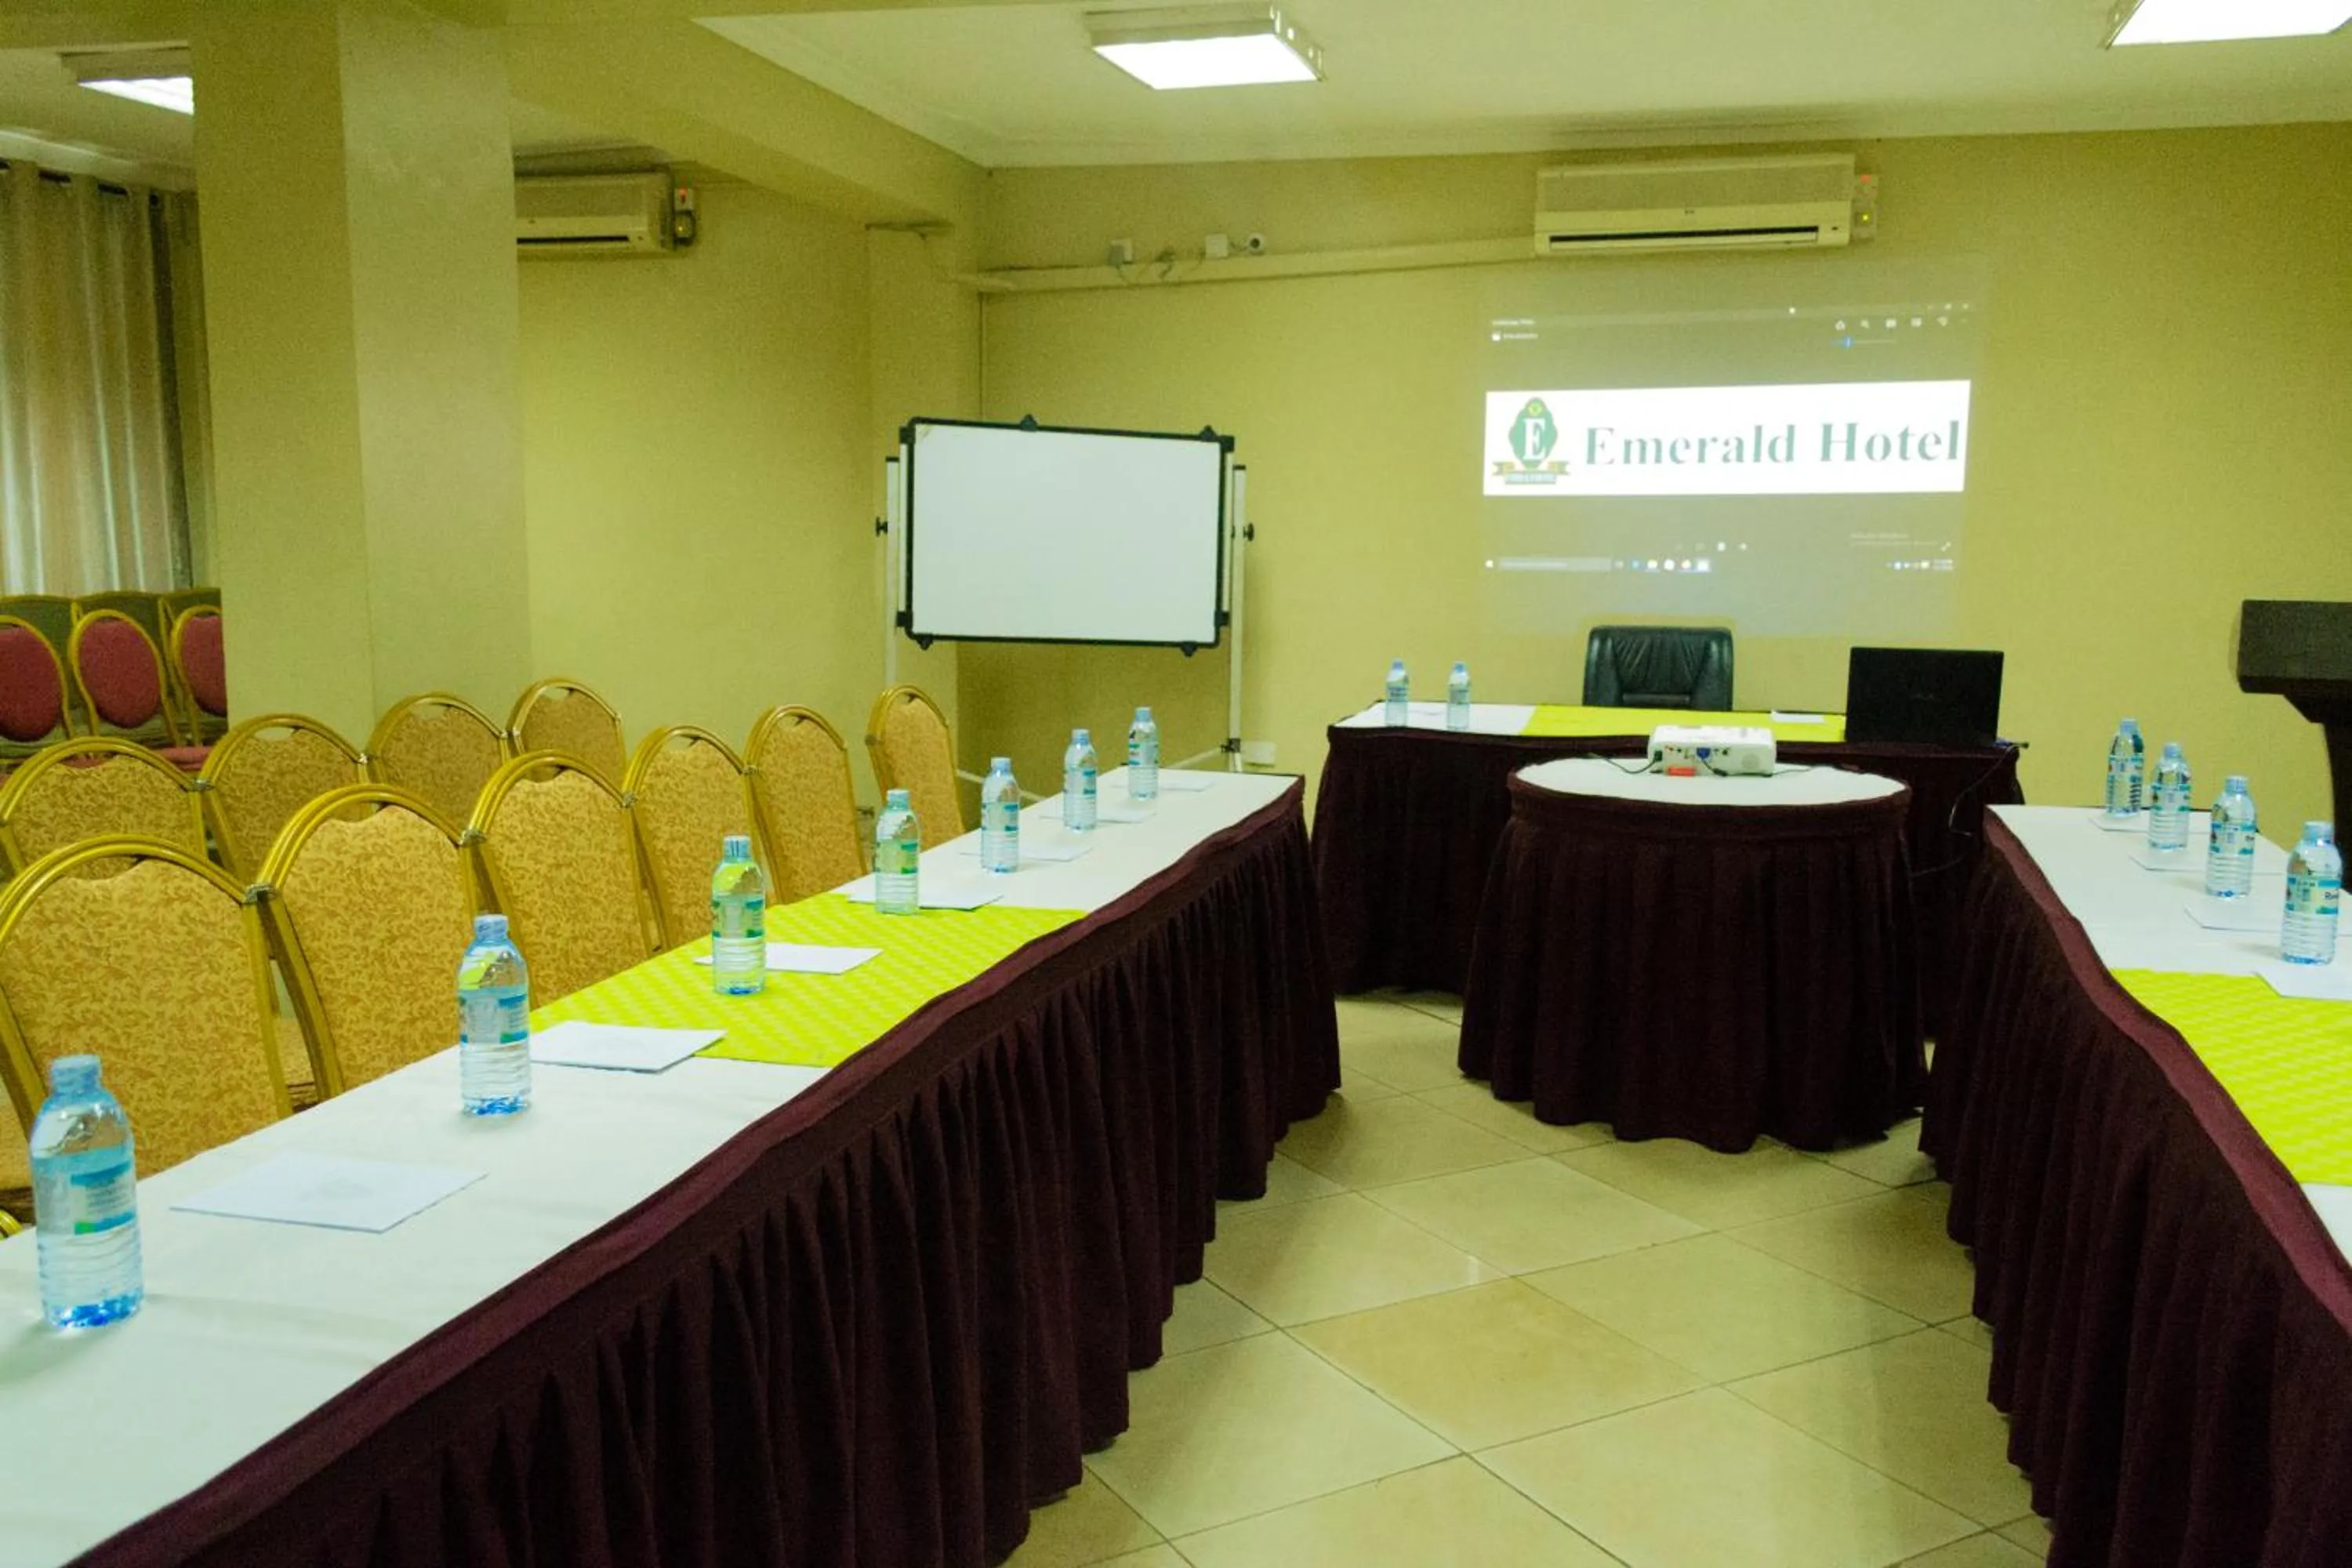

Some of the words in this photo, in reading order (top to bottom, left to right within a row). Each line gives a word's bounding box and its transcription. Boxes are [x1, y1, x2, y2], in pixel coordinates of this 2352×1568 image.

[1522, 417, 1544, 460] E
[1586, 424, 1795, 465] Emerald
[1820, 419, 1959, 462] Hotel
